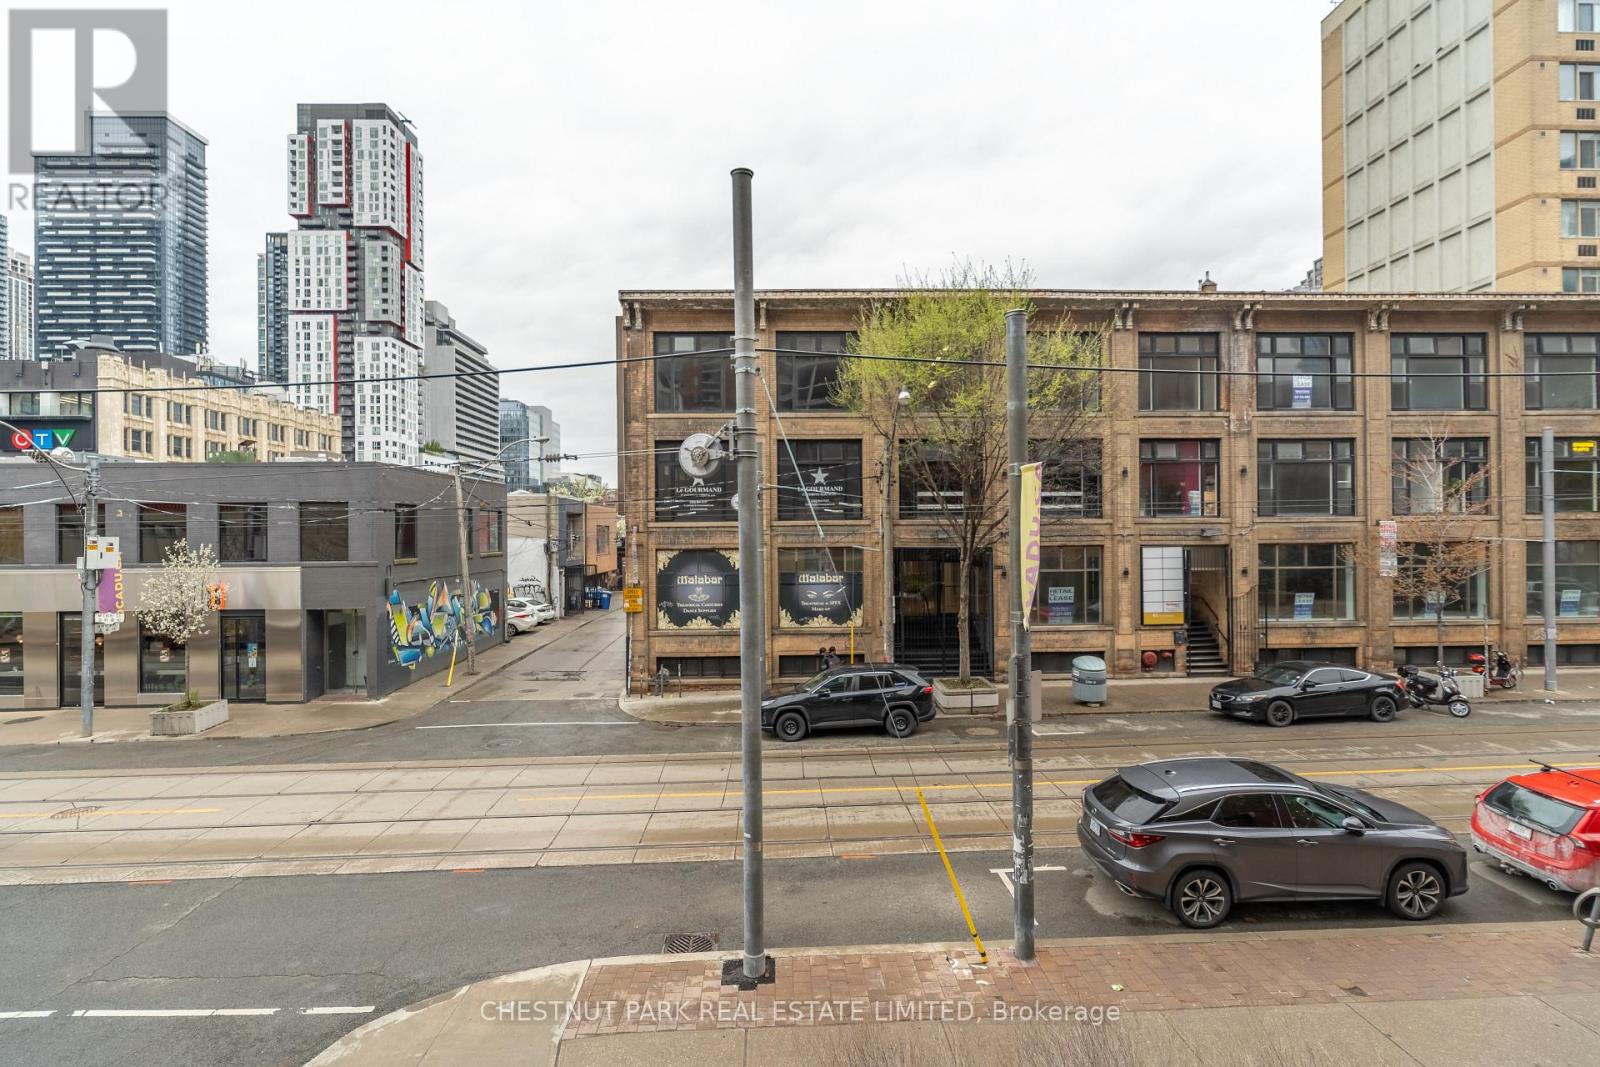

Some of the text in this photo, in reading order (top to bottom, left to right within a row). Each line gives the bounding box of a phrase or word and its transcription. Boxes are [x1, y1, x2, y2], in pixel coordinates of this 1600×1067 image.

[13, 429, 73, 448] CTV
[677, 574, 723, 585] Malabar
[799, 573, 844, 583] Malabar
